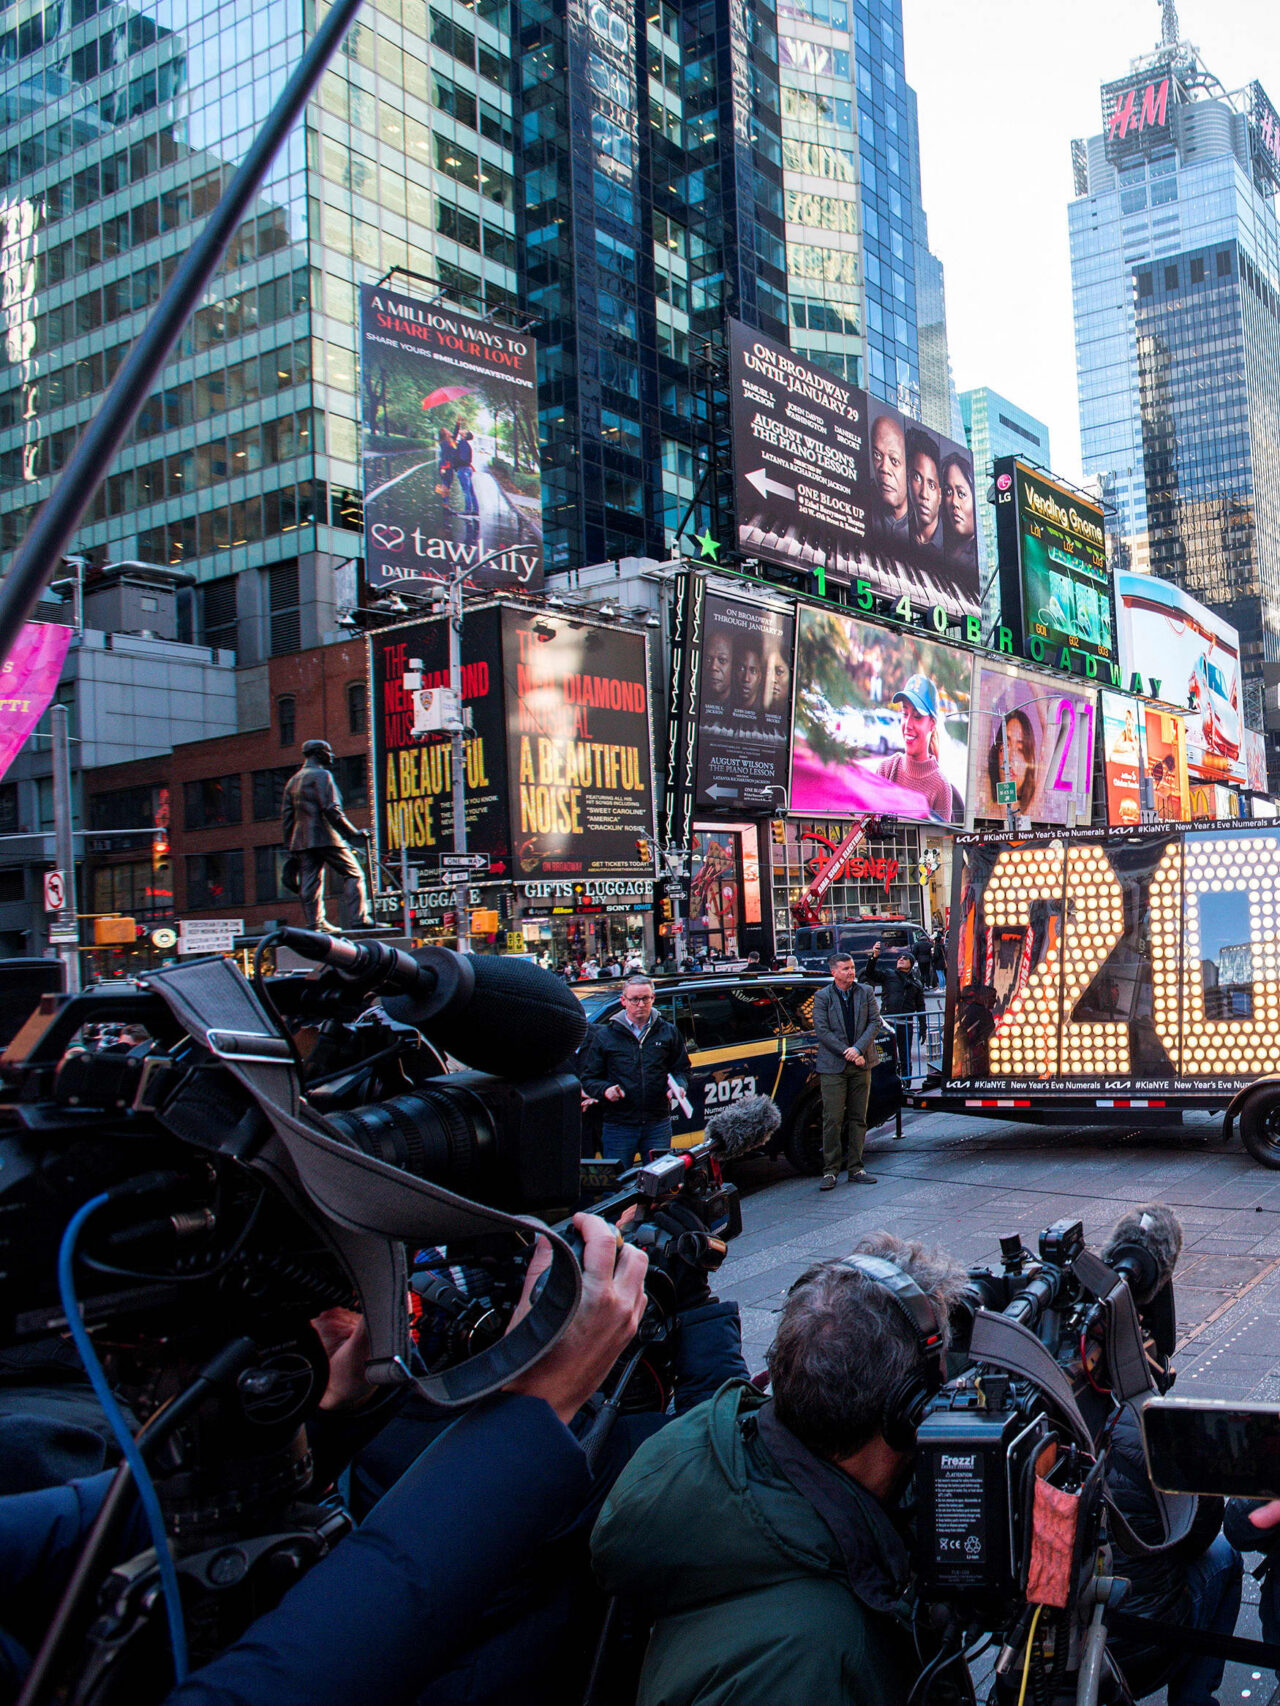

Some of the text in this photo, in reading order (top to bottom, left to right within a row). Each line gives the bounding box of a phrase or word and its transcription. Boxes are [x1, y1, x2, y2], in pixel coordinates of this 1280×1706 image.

[1108, 79, 1169, 141] H&M
[371, 296, 528, 357] A MILLION WAYS TO
[376, 312, 523, 370] SHARE YOUR LOVE
[365, 332, 534, 389] SHARE YOURS #MILLIONWAYSTOLOVE
[753, 343, 850, 404] ON BROADWAY
[742, 379, 769, 399] SAMUEL
[743, 351, 859, 422] UNTIL JANUARY 29
[743, 388, 775, 409] JACKSON
[785, 408, 827, 435] WASHINGTON
[834, 424, 862, 444] DANIELLE
[751, 422, 858, 481] THE PIANO LESSON
[753, 412, 855, 469] AUGUST WILSON'S
[797, 484, 865, 519] ONE BLOCK UP
[999, 493, 1011, 503] LG
[1025, 482, 1103, 544] Vending Gnome
[381, 564, 420, 579] DATE
[410, 527, 539, 582] tawkify
[713, 613, 747, 628] THROUGH
[726, 608, 737, 616] ON
[965, 616, 1162, 699] BROADWAY
[563, 673, 646, 713] DIAMOND
[386, 752, 398, 800] A
[519, 735, 645, 791] A BEAUTIFUL
[709, 764, 775, 777] THE PIANO LESSON
[711, 757, 774, 770] AUGUST WILSON'S
[387, 797, 436, 850] NOISE
[519, 785, 584, 834] NOISE
[984, 832, 1014, 842] #KiaNYE
[1019, 832, 1033, 841] New
[1035, 830, 1056, 840] Year's
[1057, 830, 1069, 838] Eve
[1071, 827, 1104, 838] Numerals
[1138, 824, 1170, 834] #KiaNYE
[1175, 823, 1191, 831] New
[1193, 821, 1214, 831] Year's
[1215, 820, 1230, 829] Eve
[1230, 818, 1268, 829] Numerals
[409, 889, 481, 909] LUGGAE
[525, 883, 573, 898] GIFTS
[585, 881, 653, 896] LUGGAGE
[704, 1076, 756, 1105] 2023
[974, 1080, 1006, 1090] #KiaNYE
[1011, 1081, 1026, 1089] New
[1028, 1080, 1049, 1090] Year's
[1051, 1081, 1064, 1089] Eve
[1065, 1080, 1100, 1089] Numerals
[1135, 1080, 1169, 1090] #KiaNYE
[1174, 1080, 1190, 1089] New
[1192, 1080, 1213, 1090] Year's
[1215, 1080, 1231, 1089] Eve
[941, 1455, 974, 1465] Frezzi
